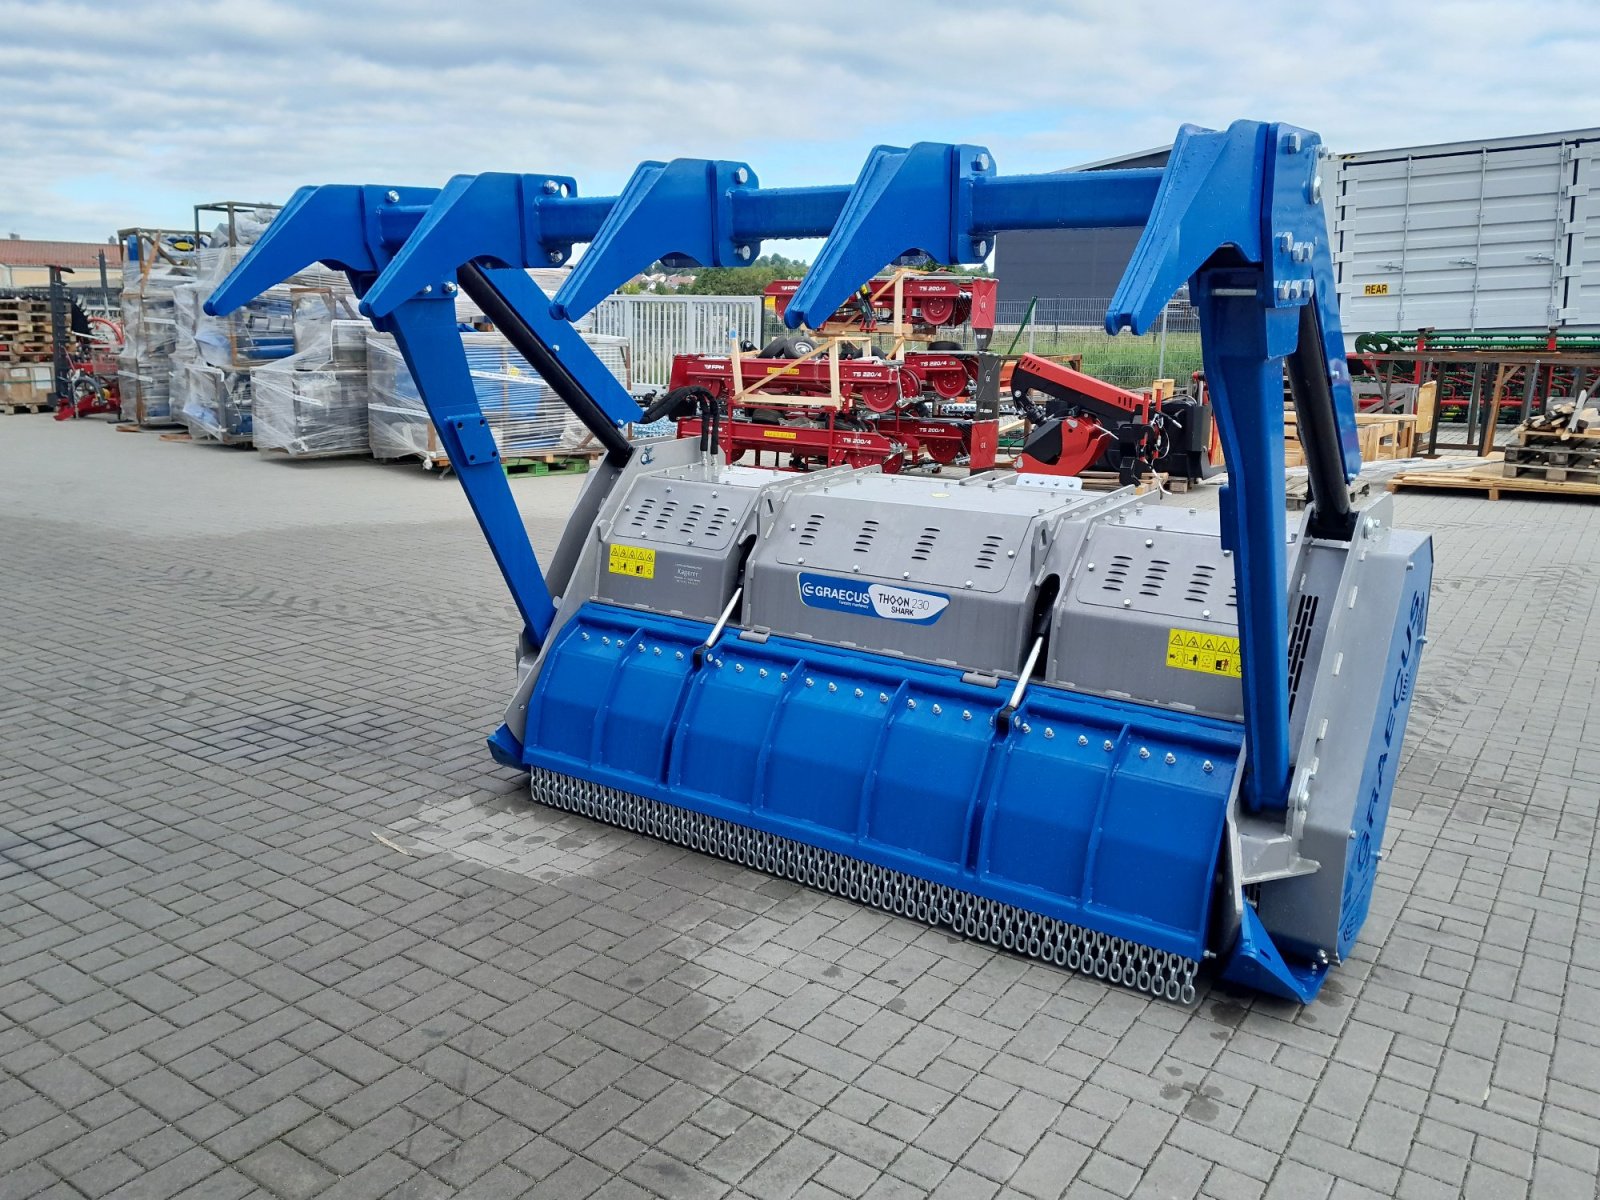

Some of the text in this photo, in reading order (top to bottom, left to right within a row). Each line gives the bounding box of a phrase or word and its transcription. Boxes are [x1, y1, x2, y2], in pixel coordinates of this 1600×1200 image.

[1365, 284, 1388, 295] REAR
[815, 586, 870, 604] GRAECUS
[878, 593, 930, 611] THOON 230
[890, 606, 914, 616] SHARK
